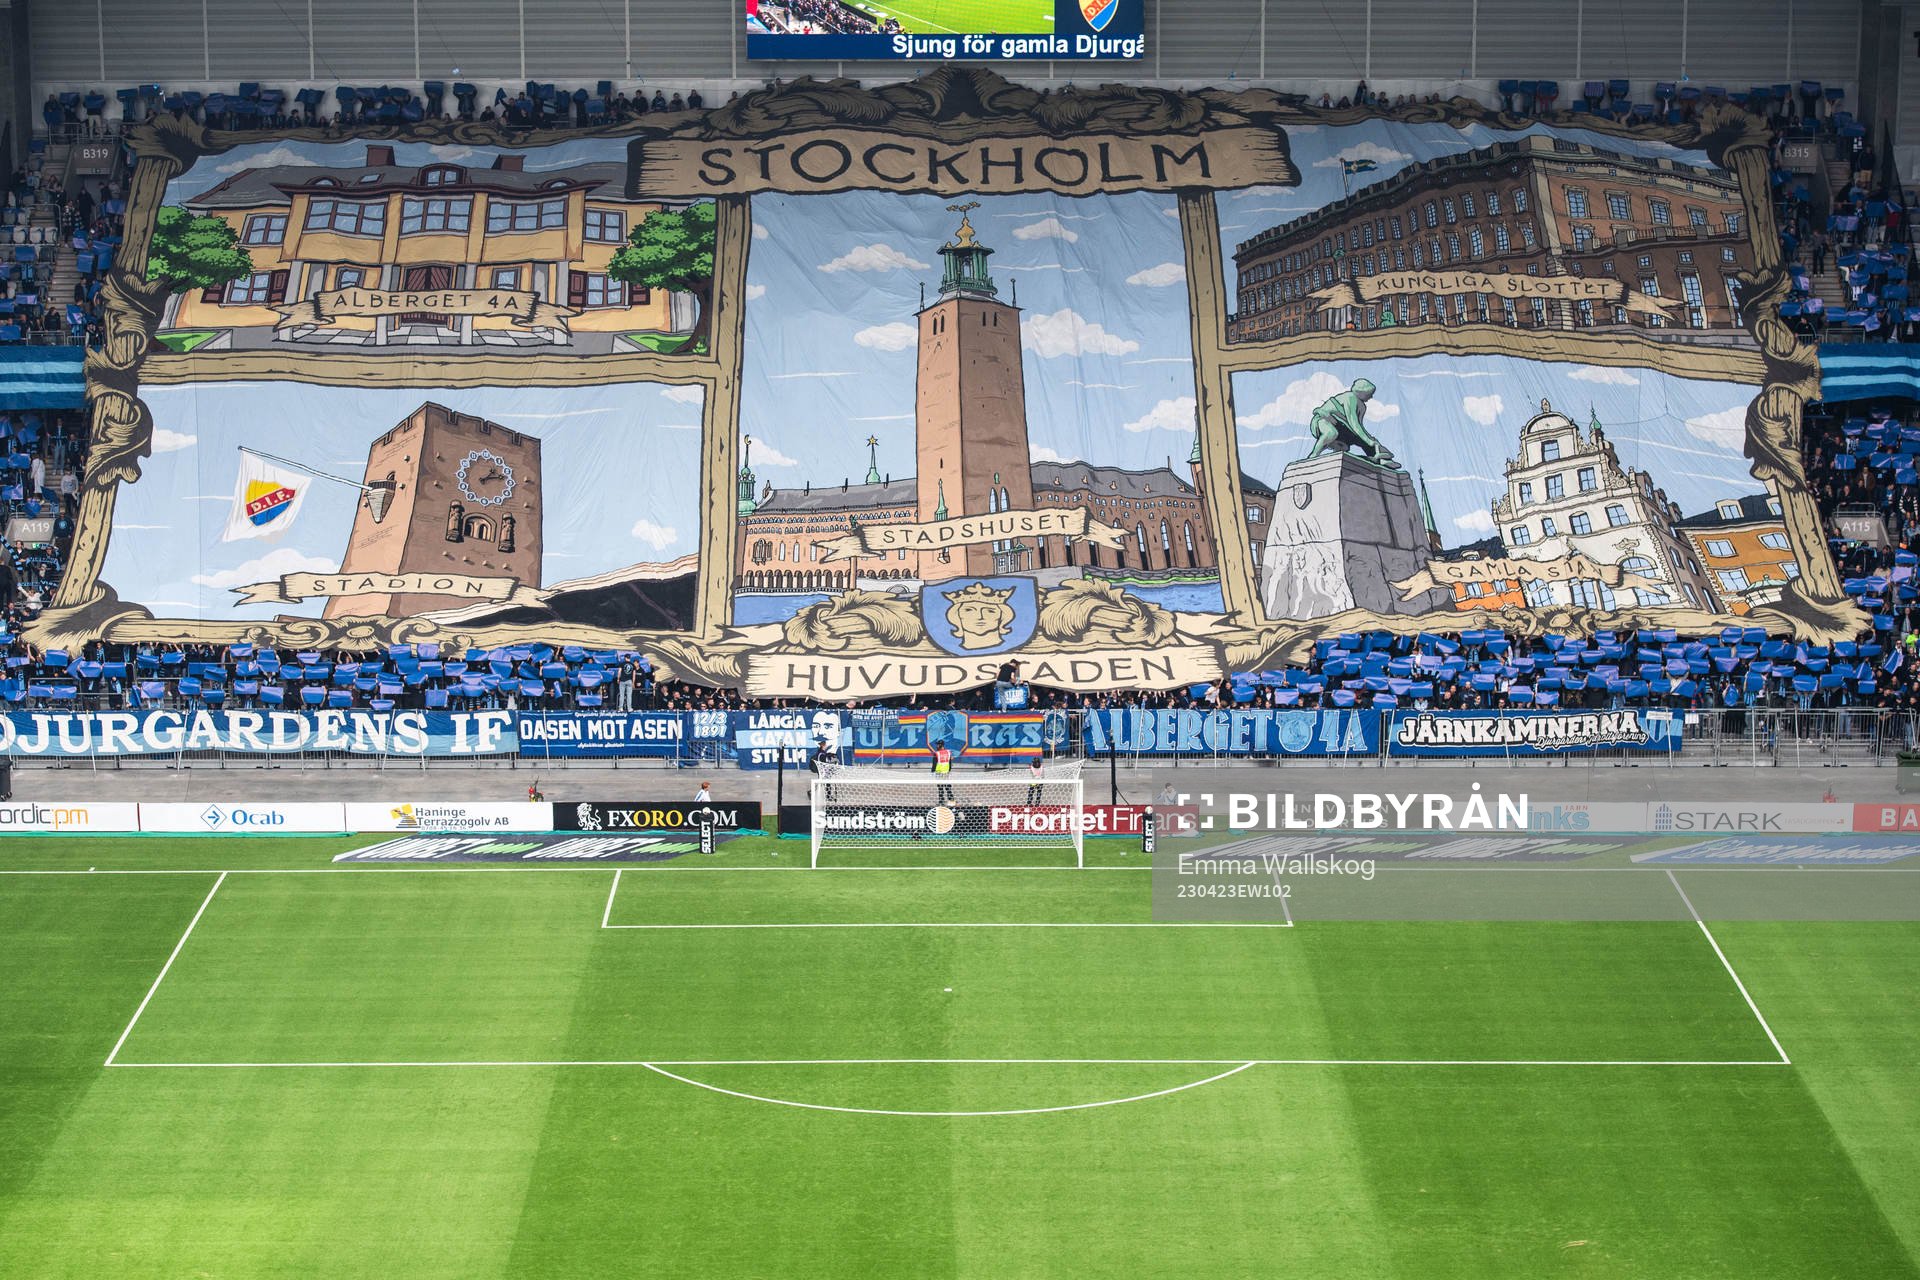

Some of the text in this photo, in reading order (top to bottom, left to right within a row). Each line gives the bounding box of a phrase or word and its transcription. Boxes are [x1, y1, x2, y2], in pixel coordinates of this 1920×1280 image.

[892, 34, 956, 57] Sjung
[963, 34, 995, 53] för
[1002, 34, 1069, 57] gamla
[83, 148, 109, 159] B319
[1784, 147, 1809, 158] B315
[698, 139, 1212, 186] STOCKHOLM
[1376, 275, 1611, 295] KUNGLIGA SLOTTET
[333, 291, 520, 309] ALBERGET 4A
[251, 490, 292, 514] D.I.F.
[21, 521, 50, 533] A119
[882, 514, 1070, 544] STADSHUSET
[1841, 520, 1871, 532] A115
[1447, 562, 1532, 578] GAMLA
[312, 577, 484, 594] STADION
[693, 711, 727, 725] 12/3
[749, 712, 807, 729] LÅNGA
[451, 711, 513, 753] IF
[520, 719, 683, 740] OASEN MOT ASEN
[693, 724, 728, 738] 1891
[1087, 709, 1273, 751] ALBERGET
[1319, 710, 1368, 751] 4A
[1400, 712, 1640, 744] JÄRNKAMINERNA
[750, 731, 807, 747] GATAN
[231, 808, 285, 826] Ocab
[415, 807, 466, 819] Haninge
[814, 811, 925, 829] Sundström
[990, 807, 1107, 831] Prioritet
[1675, 811, 1783, 830] STARK
[416, 817, 510, 829] Terrazzogolv AB
[701, 820, 711, 854] SELECT
[1144, 820, 1154, 853] SELECT
